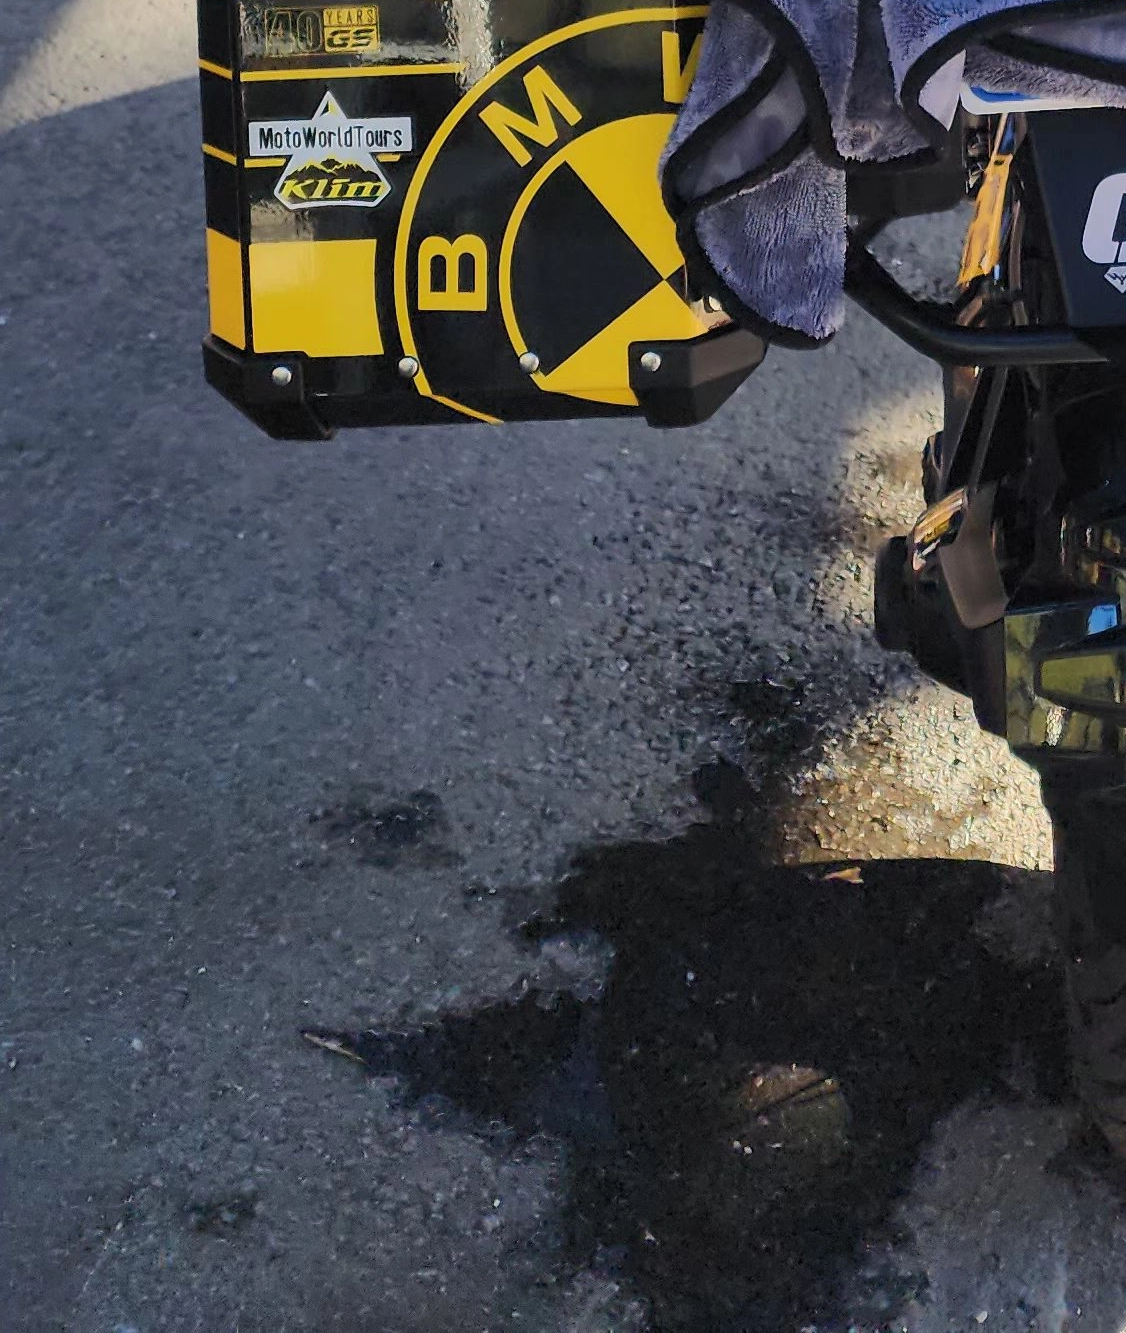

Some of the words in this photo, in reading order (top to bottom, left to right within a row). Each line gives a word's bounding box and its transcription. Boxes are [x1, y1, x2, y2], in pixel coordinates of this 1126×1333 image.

[325, 8, 375, 25] YEARS
[325, 28, 375, 48] GS
[258, 126, 403, 151] MotoWorldTours
[281, 176, 387, 201] Klim
